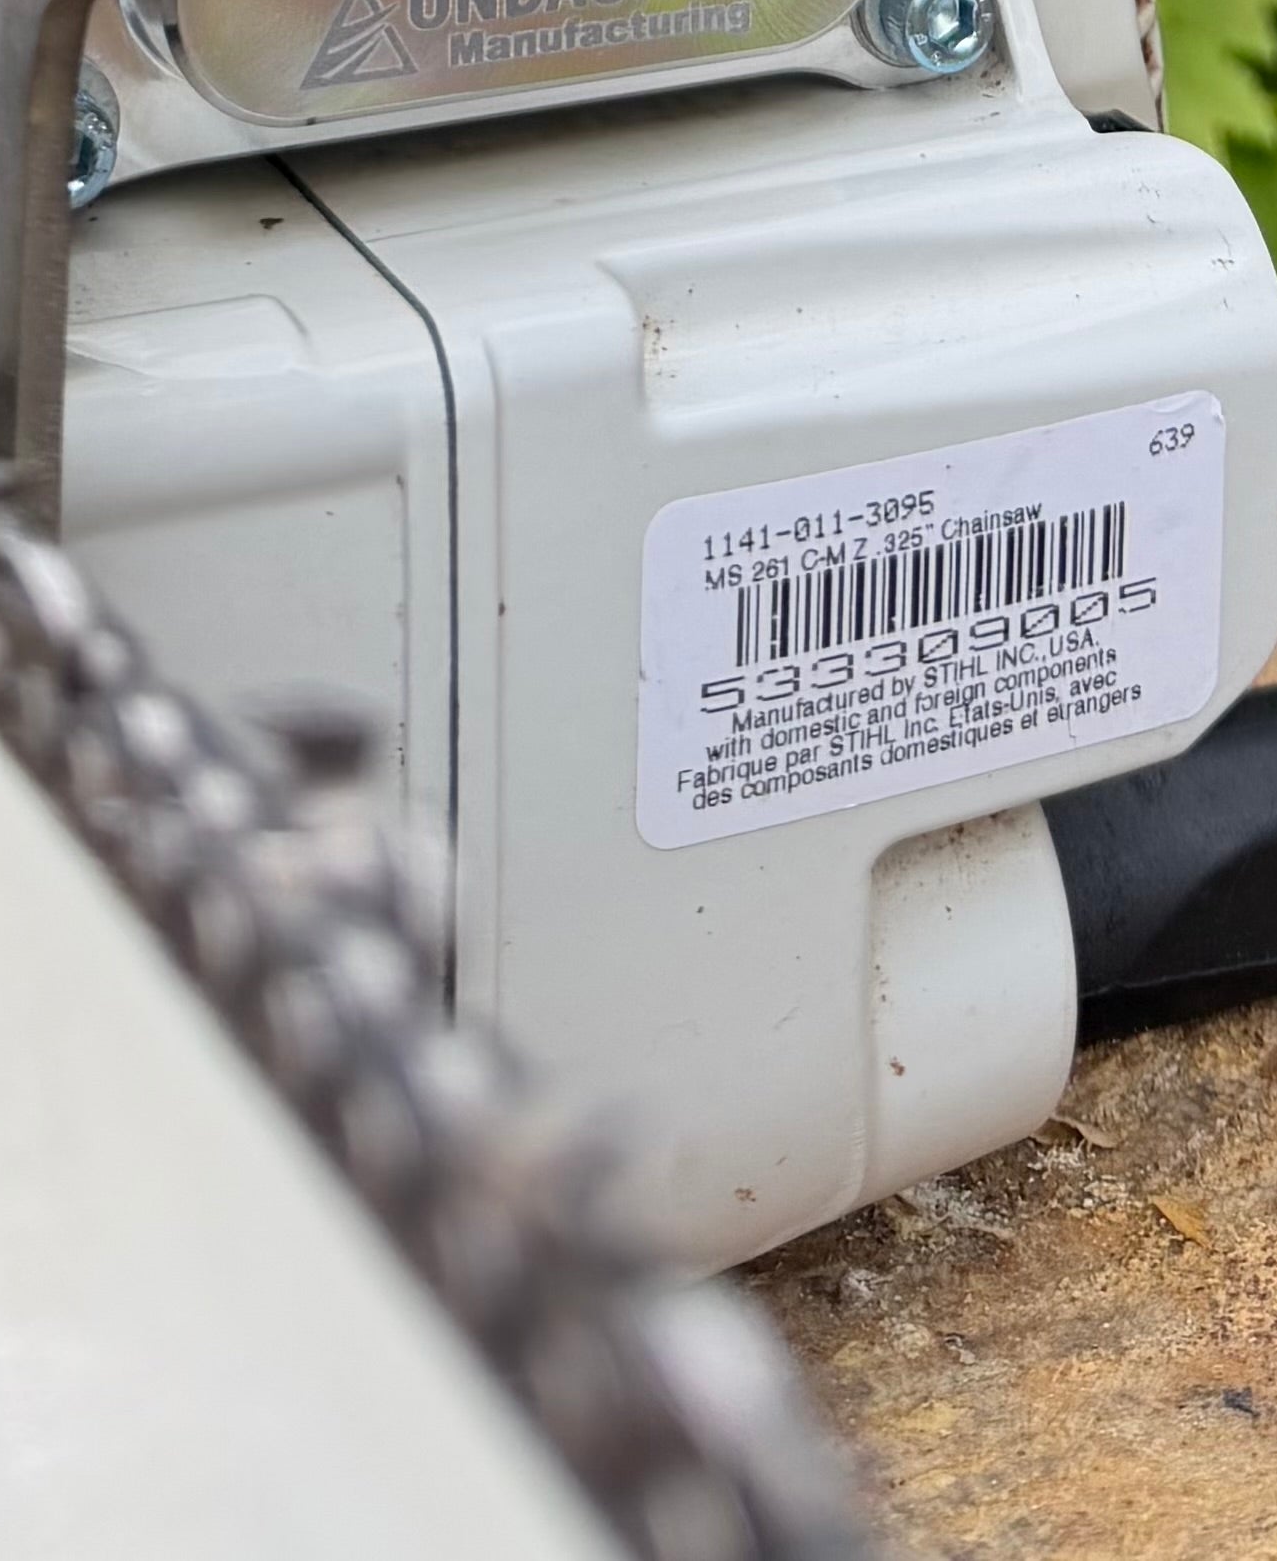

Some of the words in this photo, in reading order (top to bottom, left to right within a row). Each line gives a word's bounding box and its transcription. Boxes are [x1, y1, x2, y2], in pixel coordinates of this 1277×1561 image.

[1149, 423, 1195, 457] 639
[704, 490, 934, 561] 1141-011-3095
[705, 563, 743, 591] MS
[752, 555, 789, 582] 261
[941, 502, 1043, 541] Chainsaw
[700, 577, 1157, 714] 533309005
[677, 755, 777, 793] Fabrique
[786, 744, 822, 770] par
[829, 725, 896, 757] STIHL
[1069, 670, 1117, 697] avec
[706, 733, 752, 762] with
[760, 713, 861, 750] domestic
[867, 698, 907, 725] and
[915, 681, 986, 715] foreign
[994, 647, 1117, 694] components
[732, 678, 885, 734] Manufactured
[891, 675, 917, 699] by
[924, 655, 988, 688] STIHL
[692, 787, 732, 810] des
[741, 752, 873, 800] composants
[880, 718, 1013, 766] domestiques
[1020, 709, 1038, 730] et
